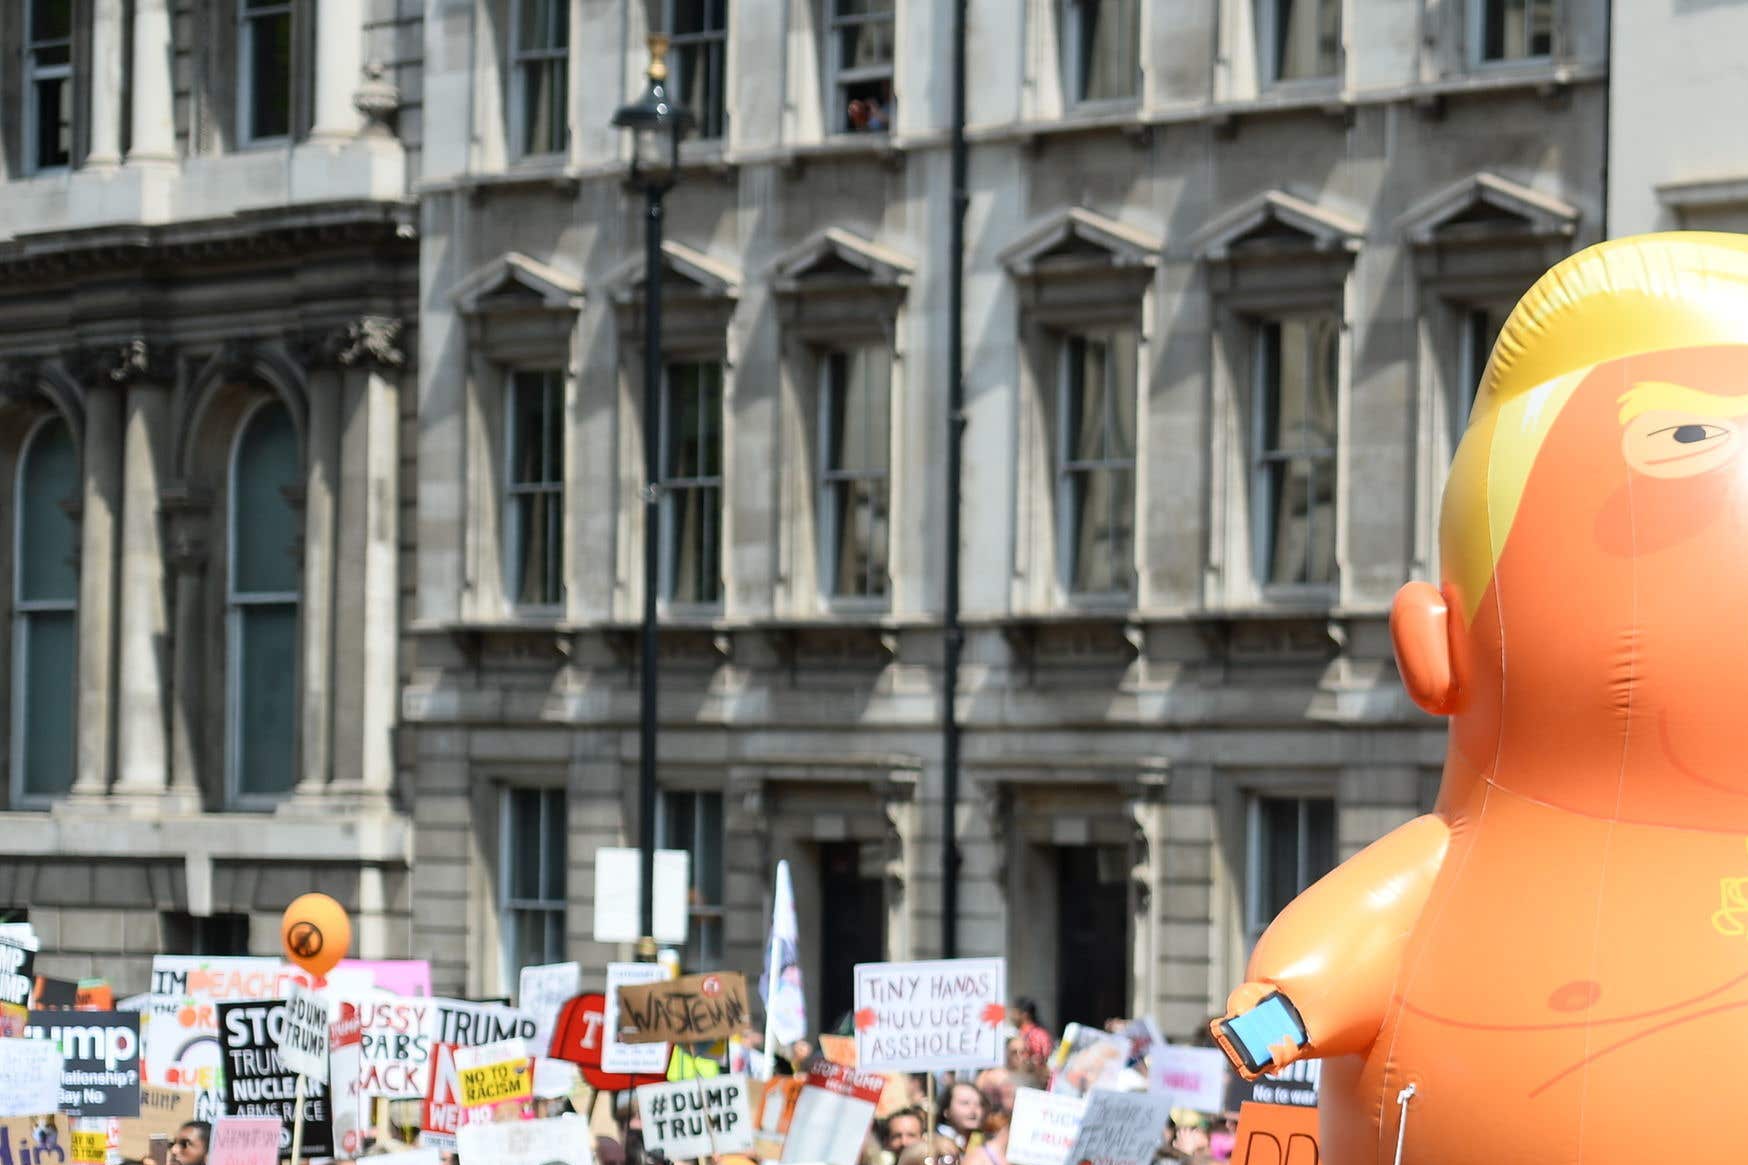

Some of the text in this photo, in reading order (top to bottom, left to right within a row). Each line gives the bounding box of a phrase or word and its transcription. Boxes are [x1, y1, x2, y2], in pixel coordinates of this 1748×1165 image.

[864, 974, 989, 1003] TINY HANDS
[439, 1007, 536, 1047] TRUMP
[878, 1004, 973, 1030] HUUUGE
[872, 1029, 981, 1061] ASSHOLE!
[464, 1066, 508, 1088] NO TO
[466, 1080, 521, 1101] RACISM
[652, 1086, 740, 1116] #DUMP
[1253, 1083, 1274, 1102] No
[1275, 1085, 1291, 1103] to
[655, 1111, 739, 1140] TRUMP
